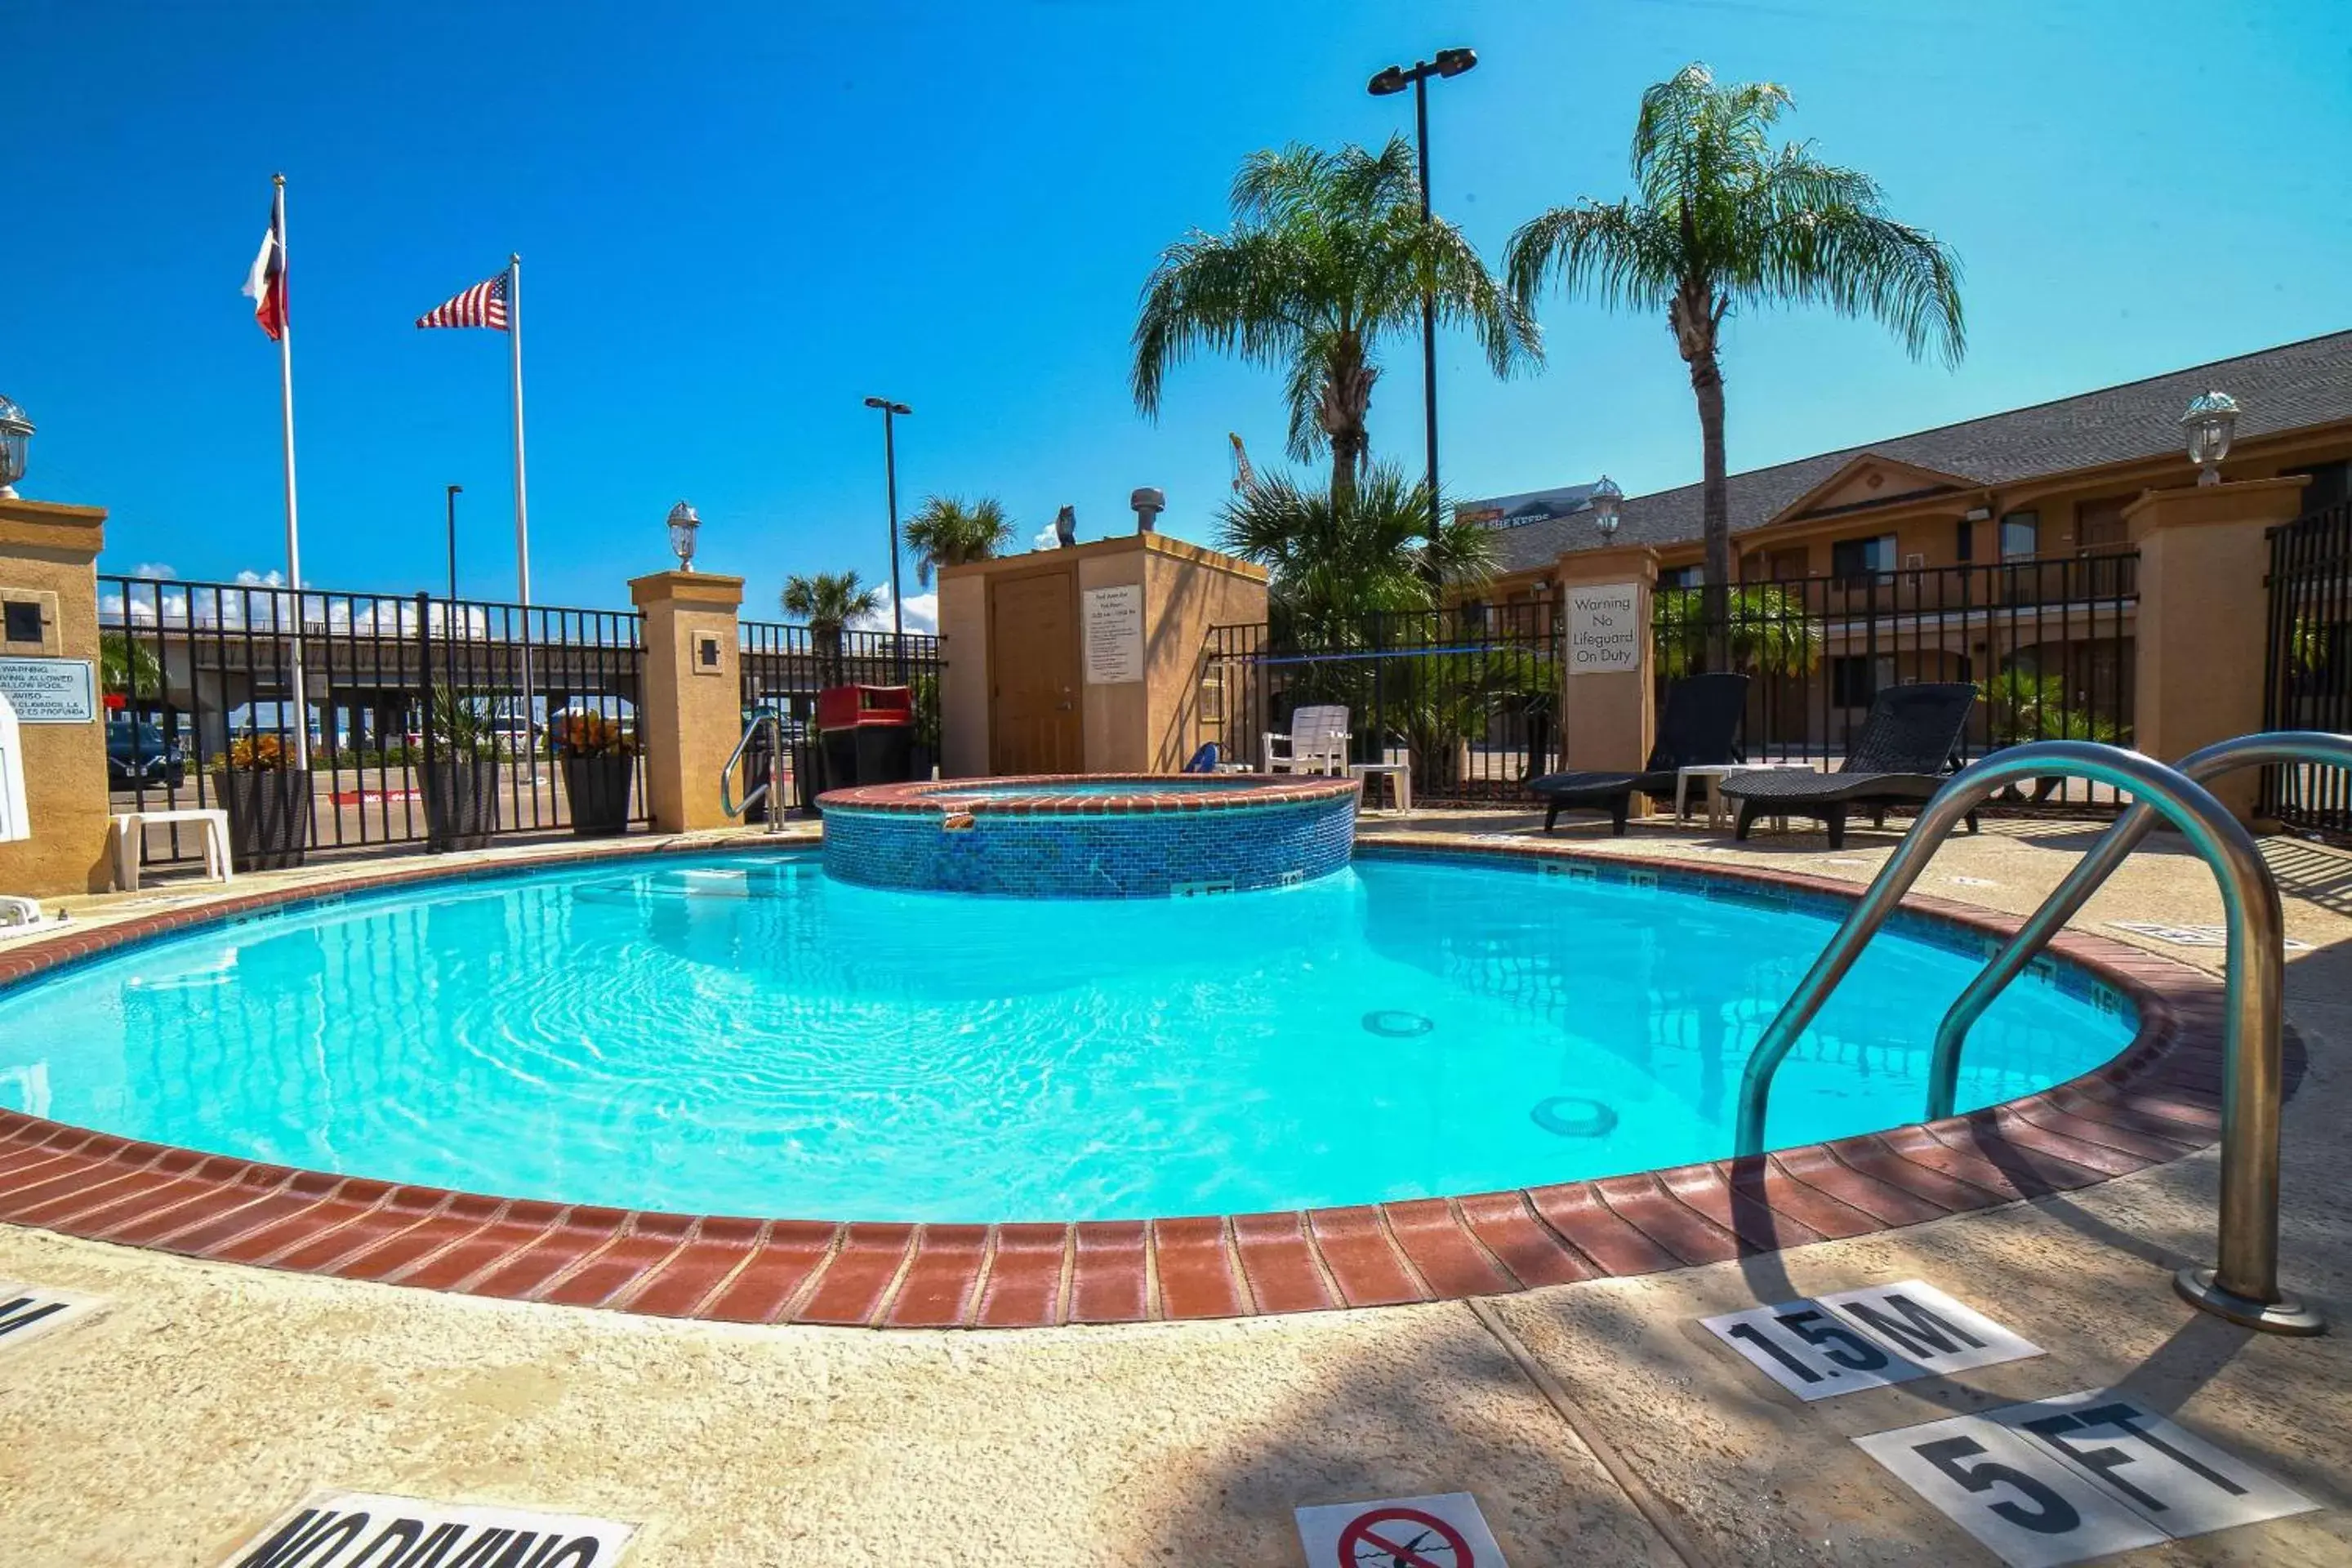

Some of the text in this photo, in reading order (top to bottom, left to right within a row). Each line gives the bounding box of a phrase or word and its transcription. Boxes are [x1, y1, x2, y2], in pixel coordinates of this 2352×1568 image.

[1575, 599, 1630, 611] Warning
[1592, 614, 1613, 626] No
[1574, 629, 1633, 648] Lifeguard
[1577, 648, 1631, 665] On Duty
[1726, 1294, 1987, 1384] 1.5 M
[1911, 1402, 2249, 1535] 5 FT
